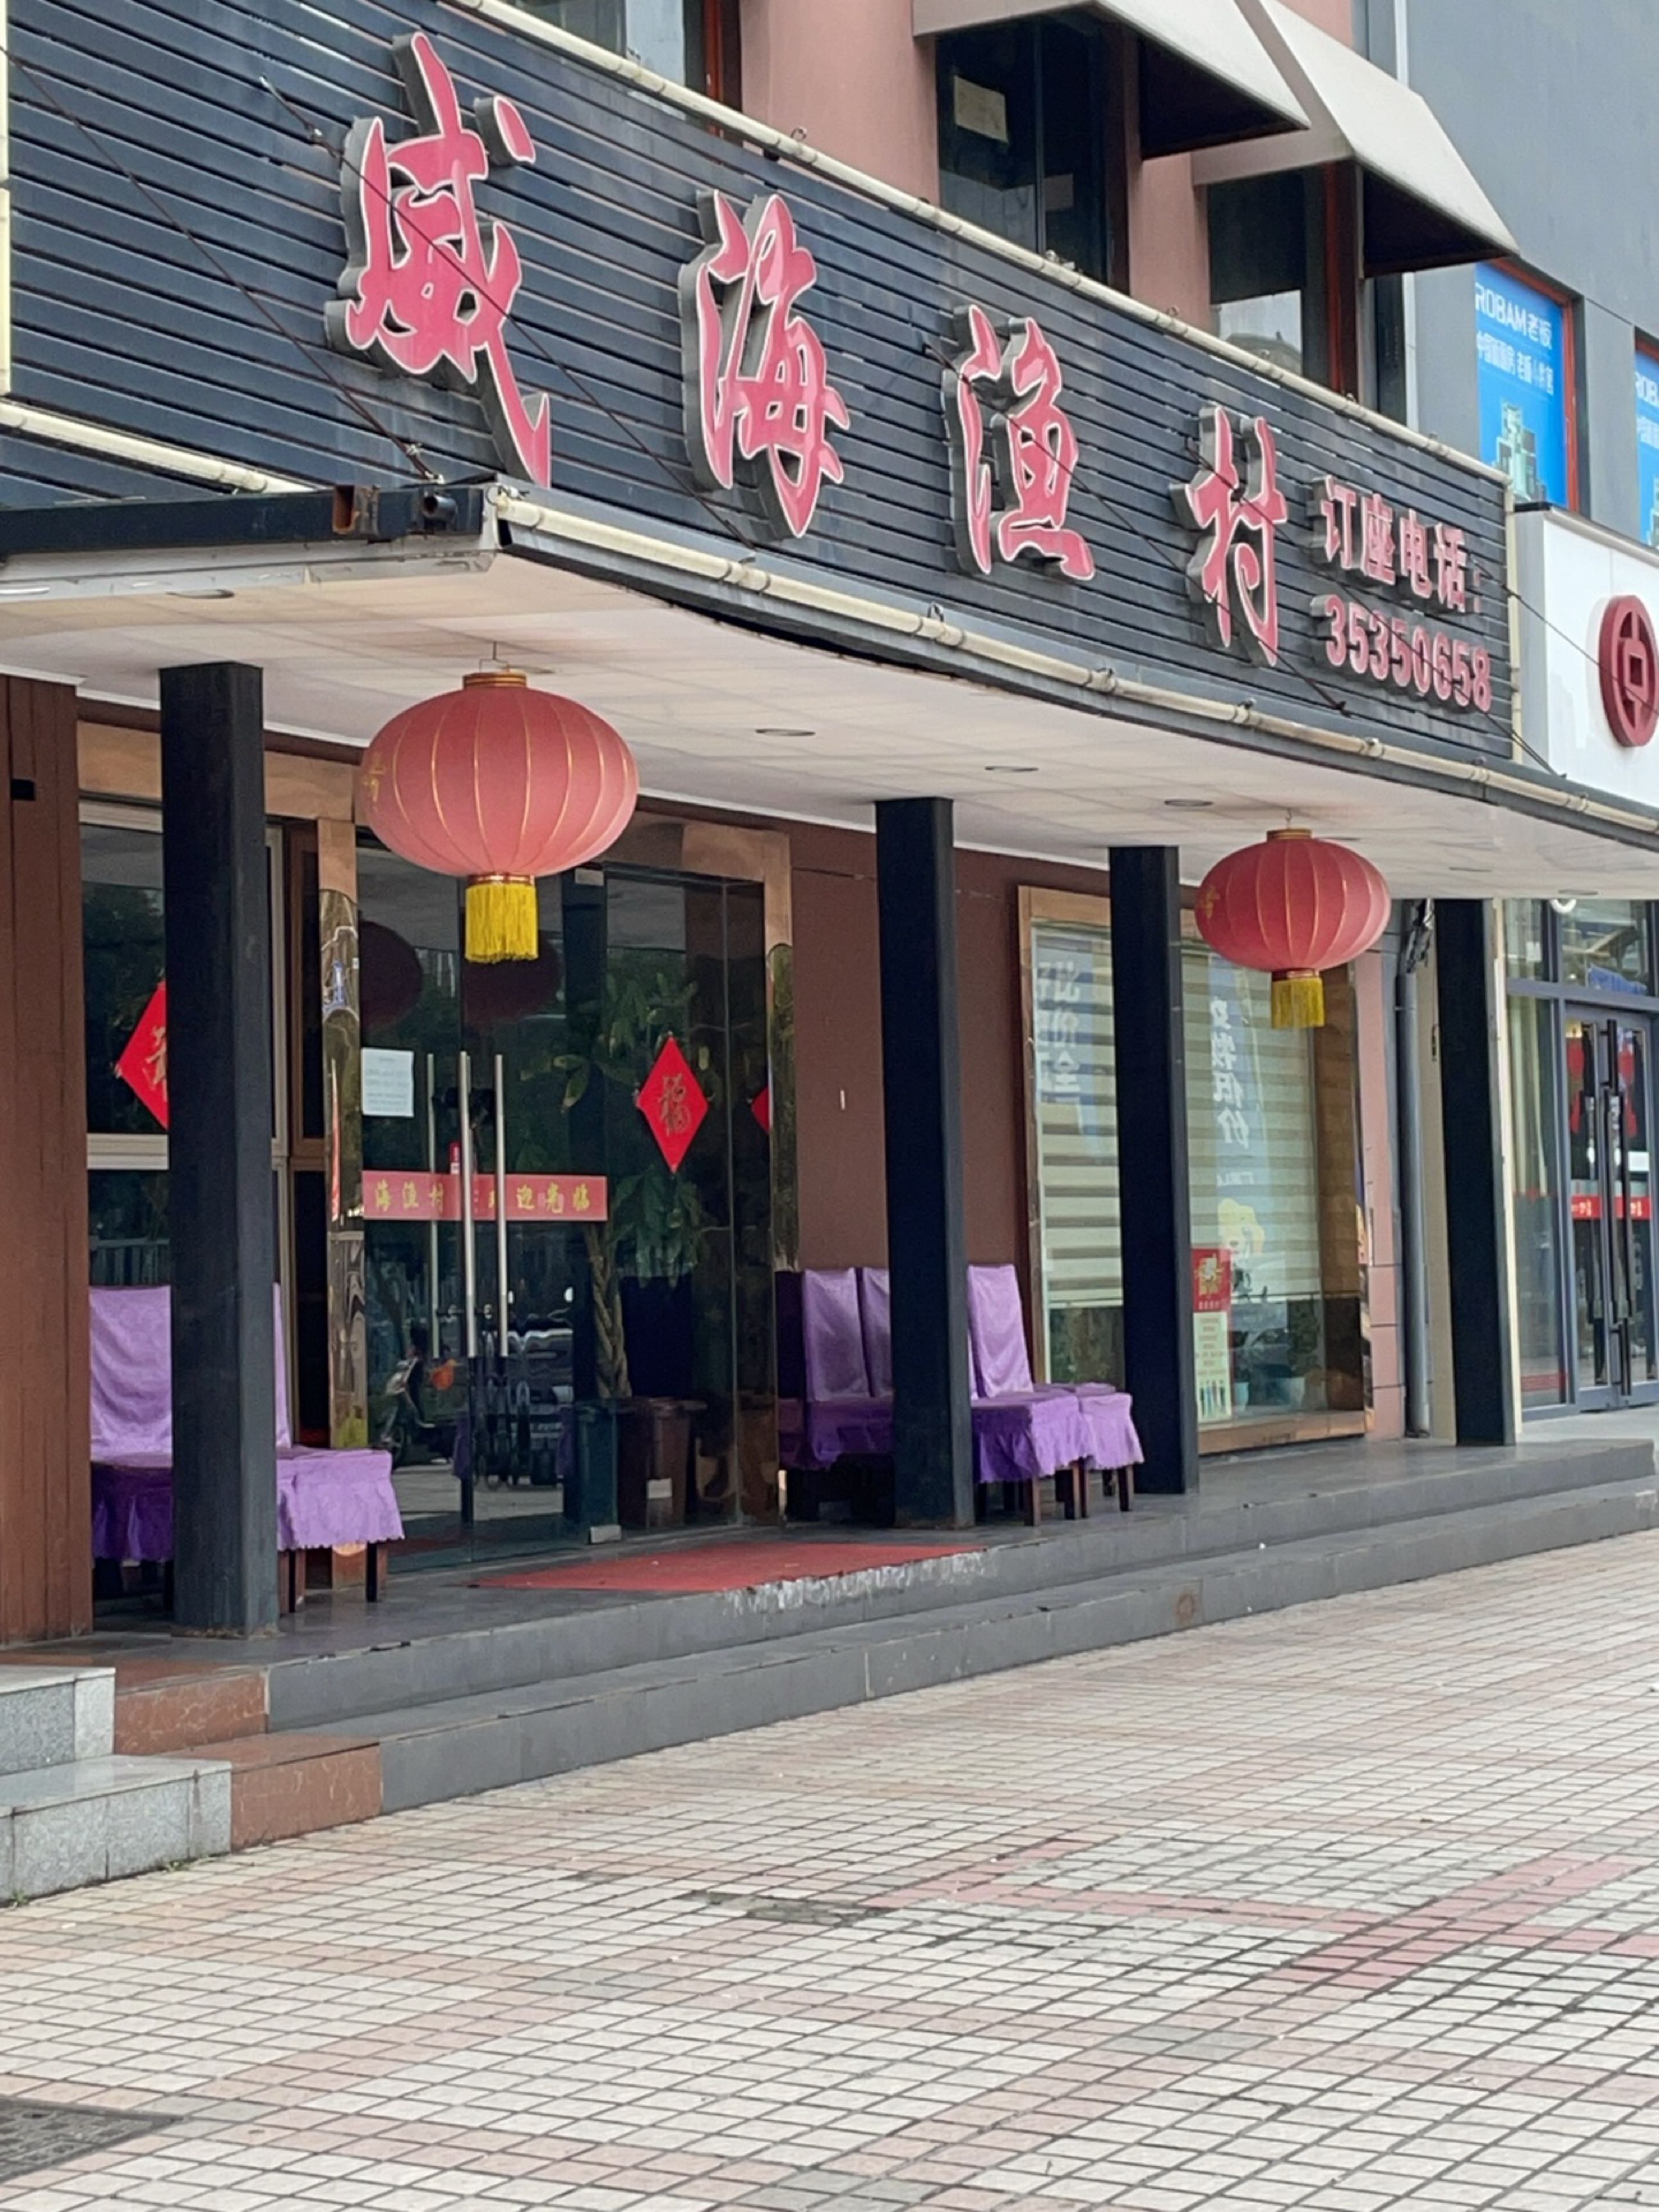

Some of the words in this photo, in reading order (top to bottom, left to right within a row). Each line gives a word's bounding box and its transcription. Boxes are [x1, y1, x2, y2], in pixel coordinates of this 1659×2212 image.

[344, 32, 1287, 668] 威海渔村
[1324, 595, 1493, 712] 35350658
